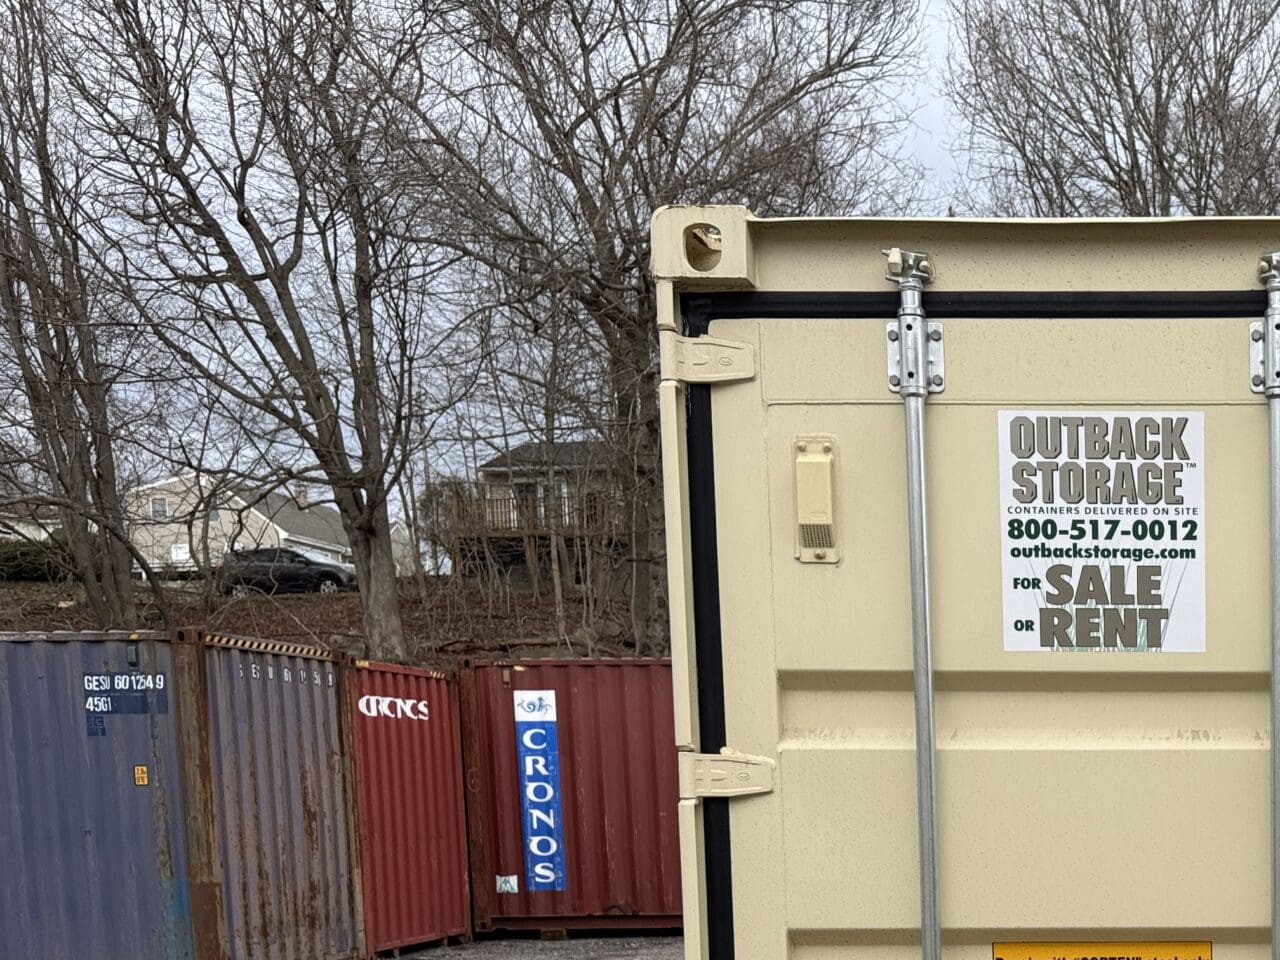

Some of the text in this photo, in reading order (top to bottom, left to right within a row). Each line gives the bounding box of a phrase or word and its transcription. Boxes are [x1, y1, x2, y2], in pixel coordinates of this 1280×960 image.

[1010, 416, 1190, 460] OUTBACK
[1012, 461, 1184, 505] STORAGE
[1007, 506, 1198, 516] CONTAINERS DELIVERED ON SITE
[1007, 518, 1198, 541] 800-517-0012
[1010, 543, 1196, 561] outbackstorage.com
[1013, 564, 1162, 605] FOR SALE
[1014, 608, 1169, 647] OR RENT
[84, 675, 110, 690] GESU
[522, 728, 557, 883] CRONOS
